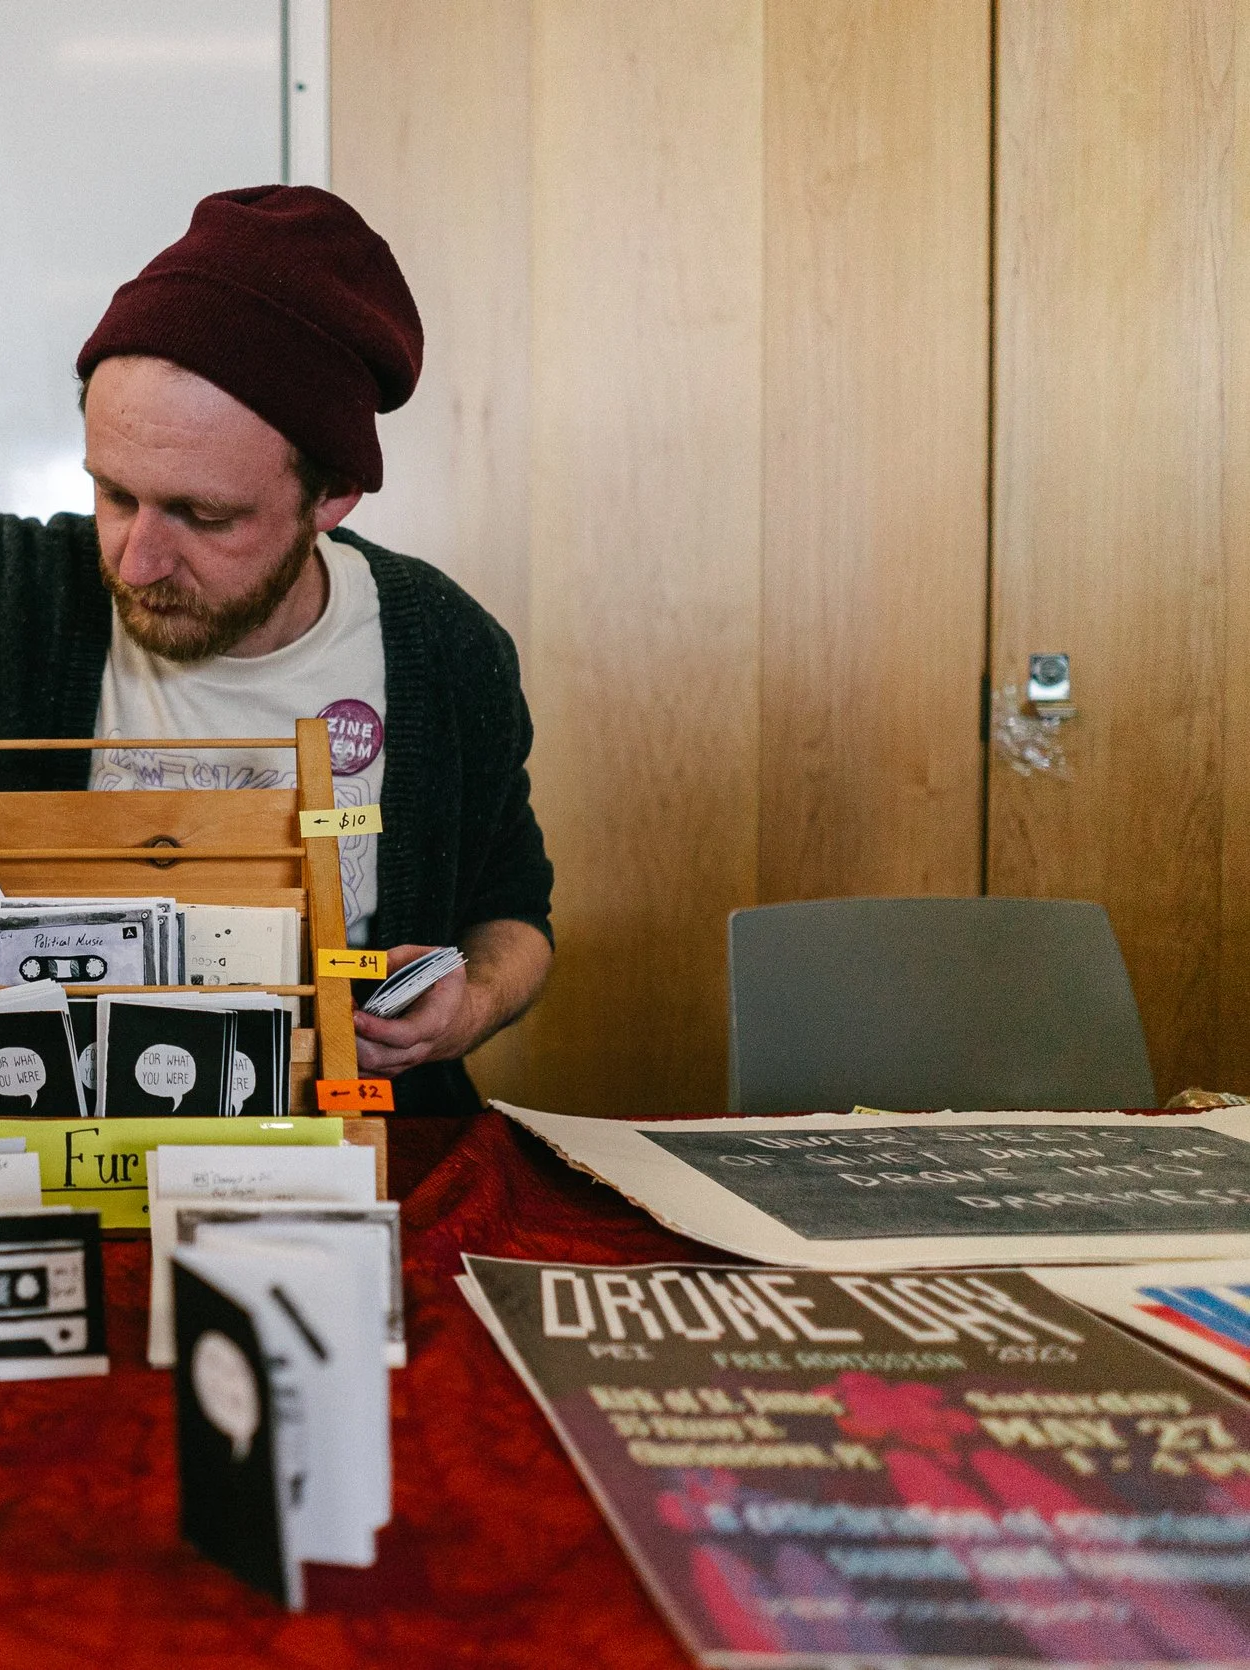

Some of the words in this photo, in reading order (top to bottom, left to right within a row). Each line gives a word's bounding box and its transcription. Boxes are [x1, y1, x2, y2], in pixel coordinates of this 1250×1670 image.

[327, 717, 373, 738] ZINE
[331, 738, 372, 761] EAM
[339, 812, 366, 829] $10
[34, 933, 70, 948] Political
[76, 933, 103, 946] Music
[359, 955, 378, 972] $4
[14, 1053, 38, 1067] WHAT
[85, 1049, 97, 1061] FO
[143, 1052, 161, 1065] FOR
[166, 1055, 190, 1067] WHAT
[17, 1070, 41, 1083] WERE
[85, 1068, 97, 1081] YO
[142, 1072, 160, 1085] YOU
[166, 1073, 190, 1085] WERE
[358, 1084, 383, 1099] $2
[745, 1133, 916, 1149] UNDER
[63, 1127, 147, 1188] Fur
[717, 1153, 777, 1167] OF
[804, 1151, 950, 1165] QUIET
[976, 1148, 1106, 1160] DAWN
[1146, 1146, 1228, 1157] WE
[540, 1269, 863, 1342] DRONE
[833, 1275, 1085, 1343] DAY
[964, 1389, 1191, 1415] Saturday
[979, 1416, 1127, 1449] MAY
[1136, 1414, 1235, 1449] 27
